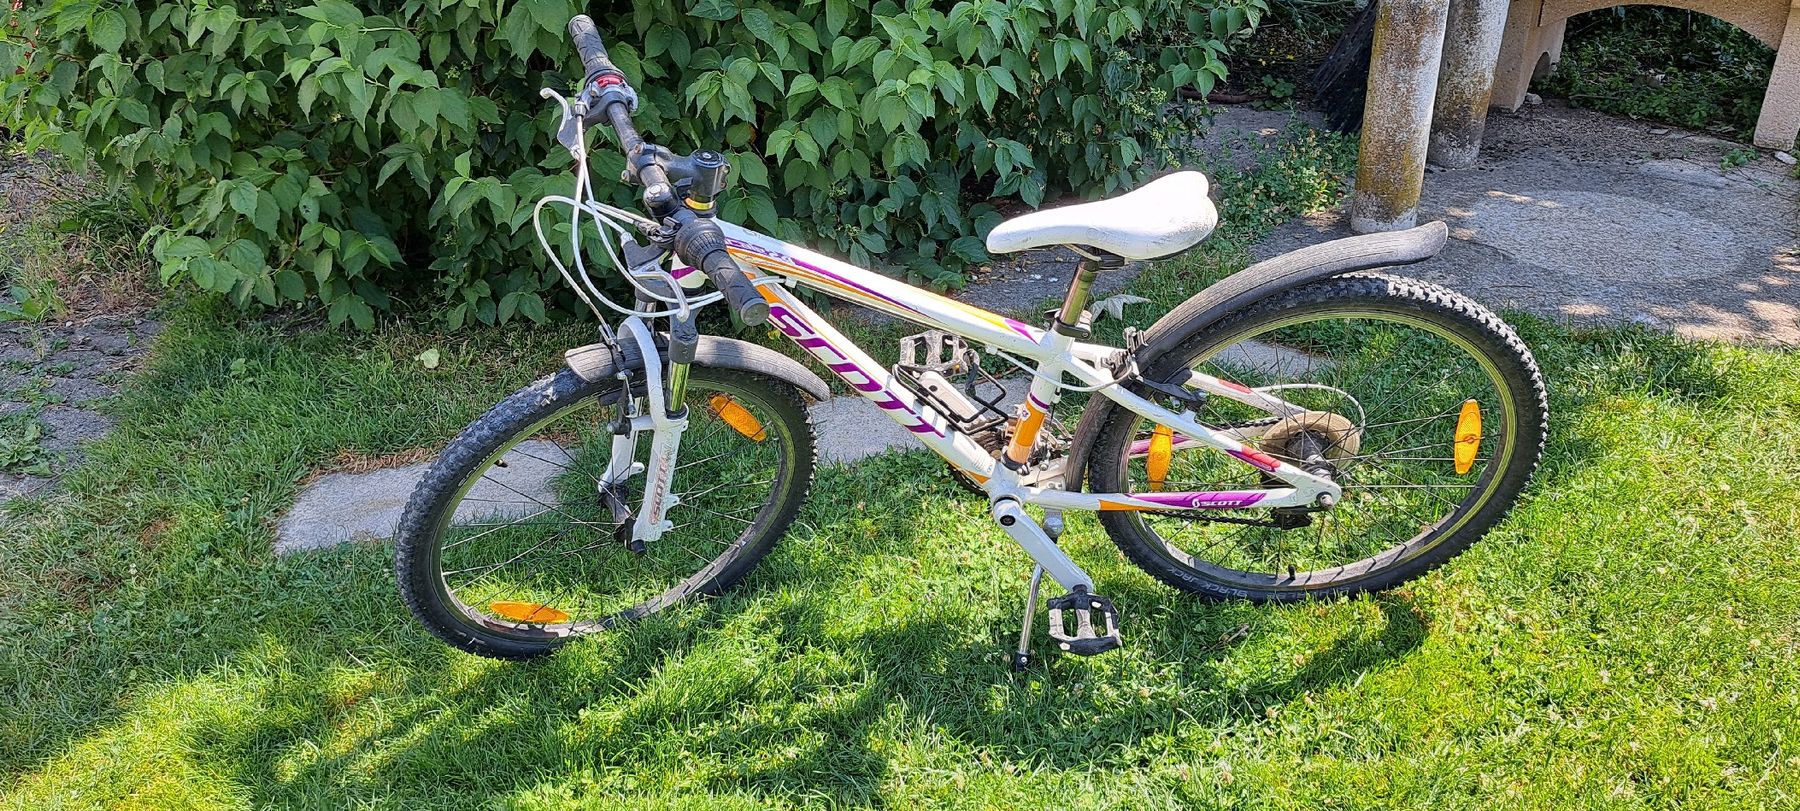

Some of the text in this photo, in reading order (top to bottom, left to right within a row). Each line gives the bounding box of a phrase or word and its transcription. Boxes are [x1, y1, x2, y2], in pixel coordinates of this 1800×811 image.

[769, 306, 946, 439] SCOTT
[653, 461, 668, 517] SCOTT
[1166, 567, 1248, 598] BLACK JACK
